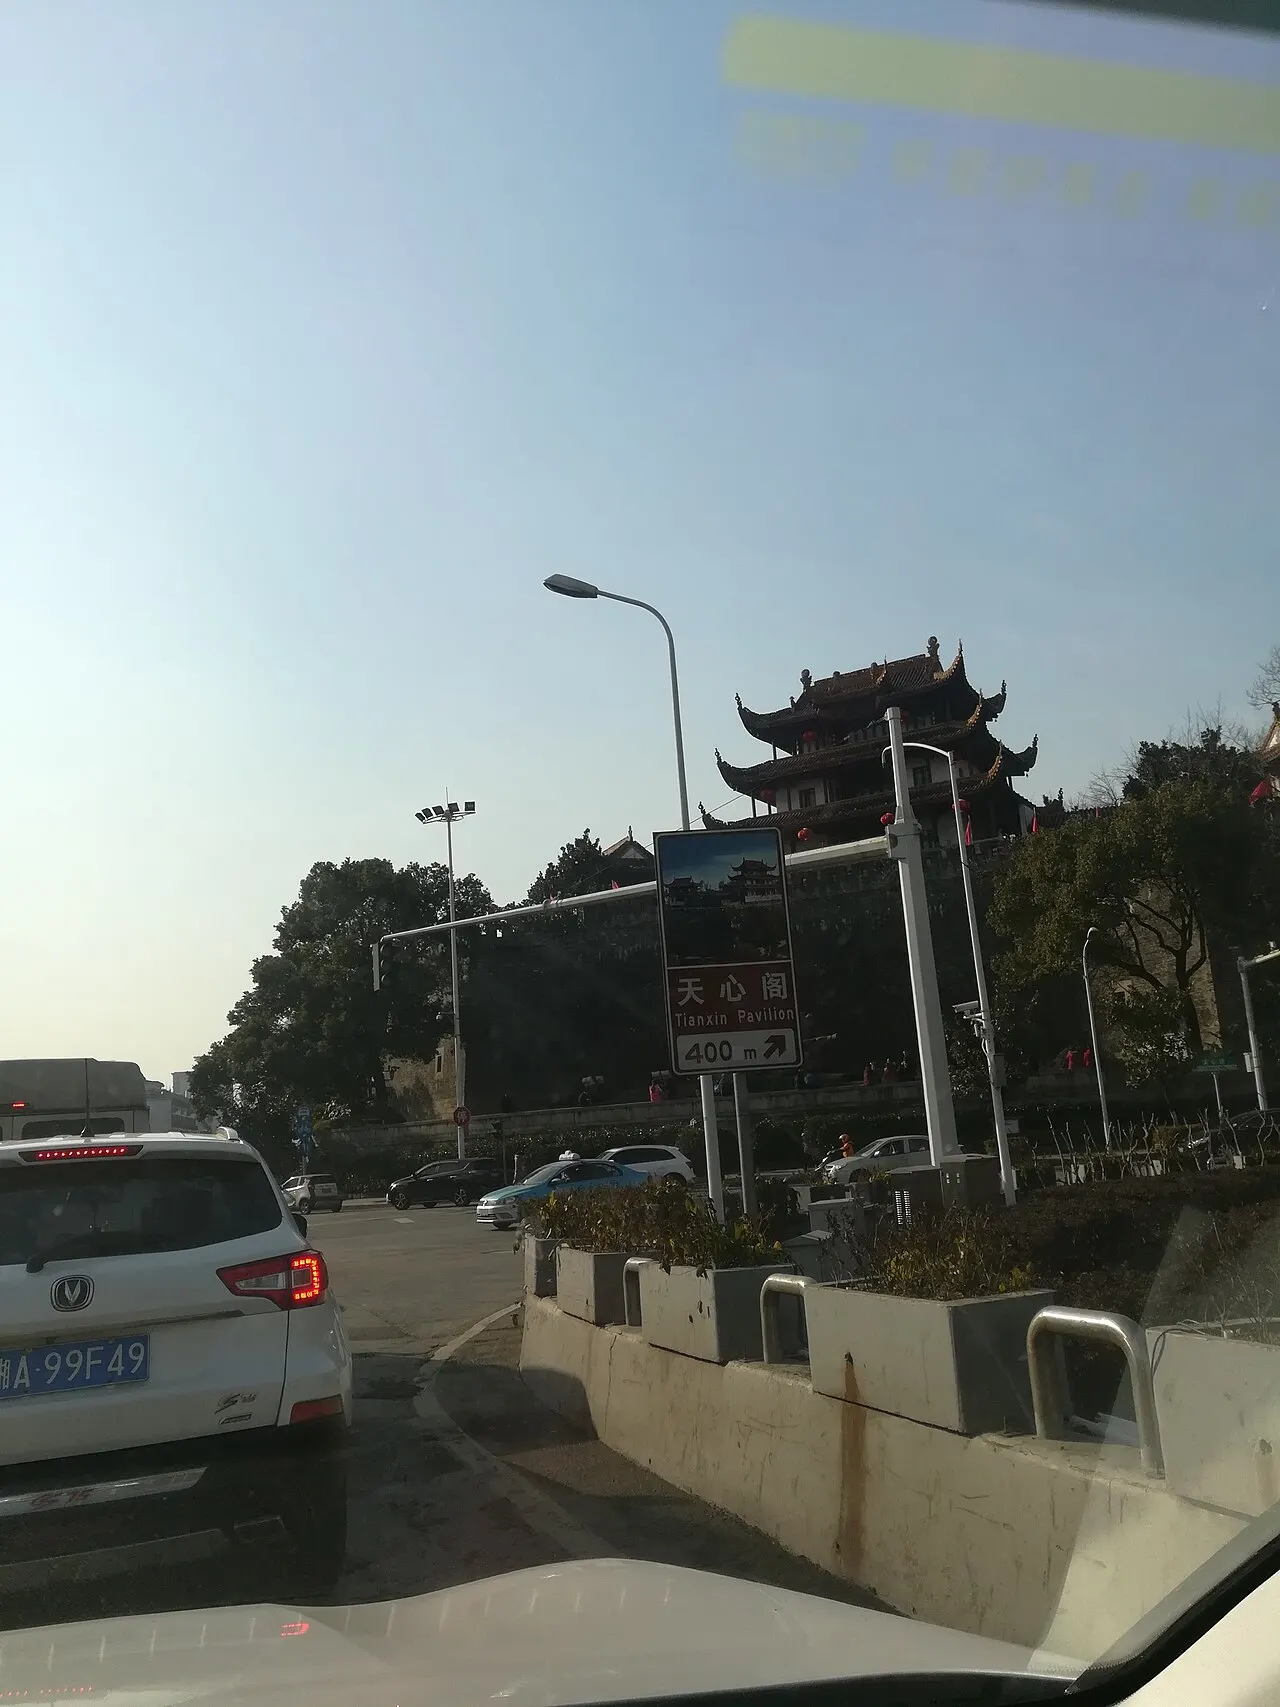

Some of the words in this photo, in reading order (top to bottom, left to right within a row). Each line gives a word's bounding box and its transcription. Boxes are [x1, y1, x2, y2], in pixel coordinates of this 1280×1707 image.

[677, 972, 788, 1006] 天心阁
[675, 1012, 728, 1027] Tianxin
[737, 1007, 794, 1024] Pavilion
[684, 1040, 733, 1064] 400
[743, 1048, 757, 1060] m
